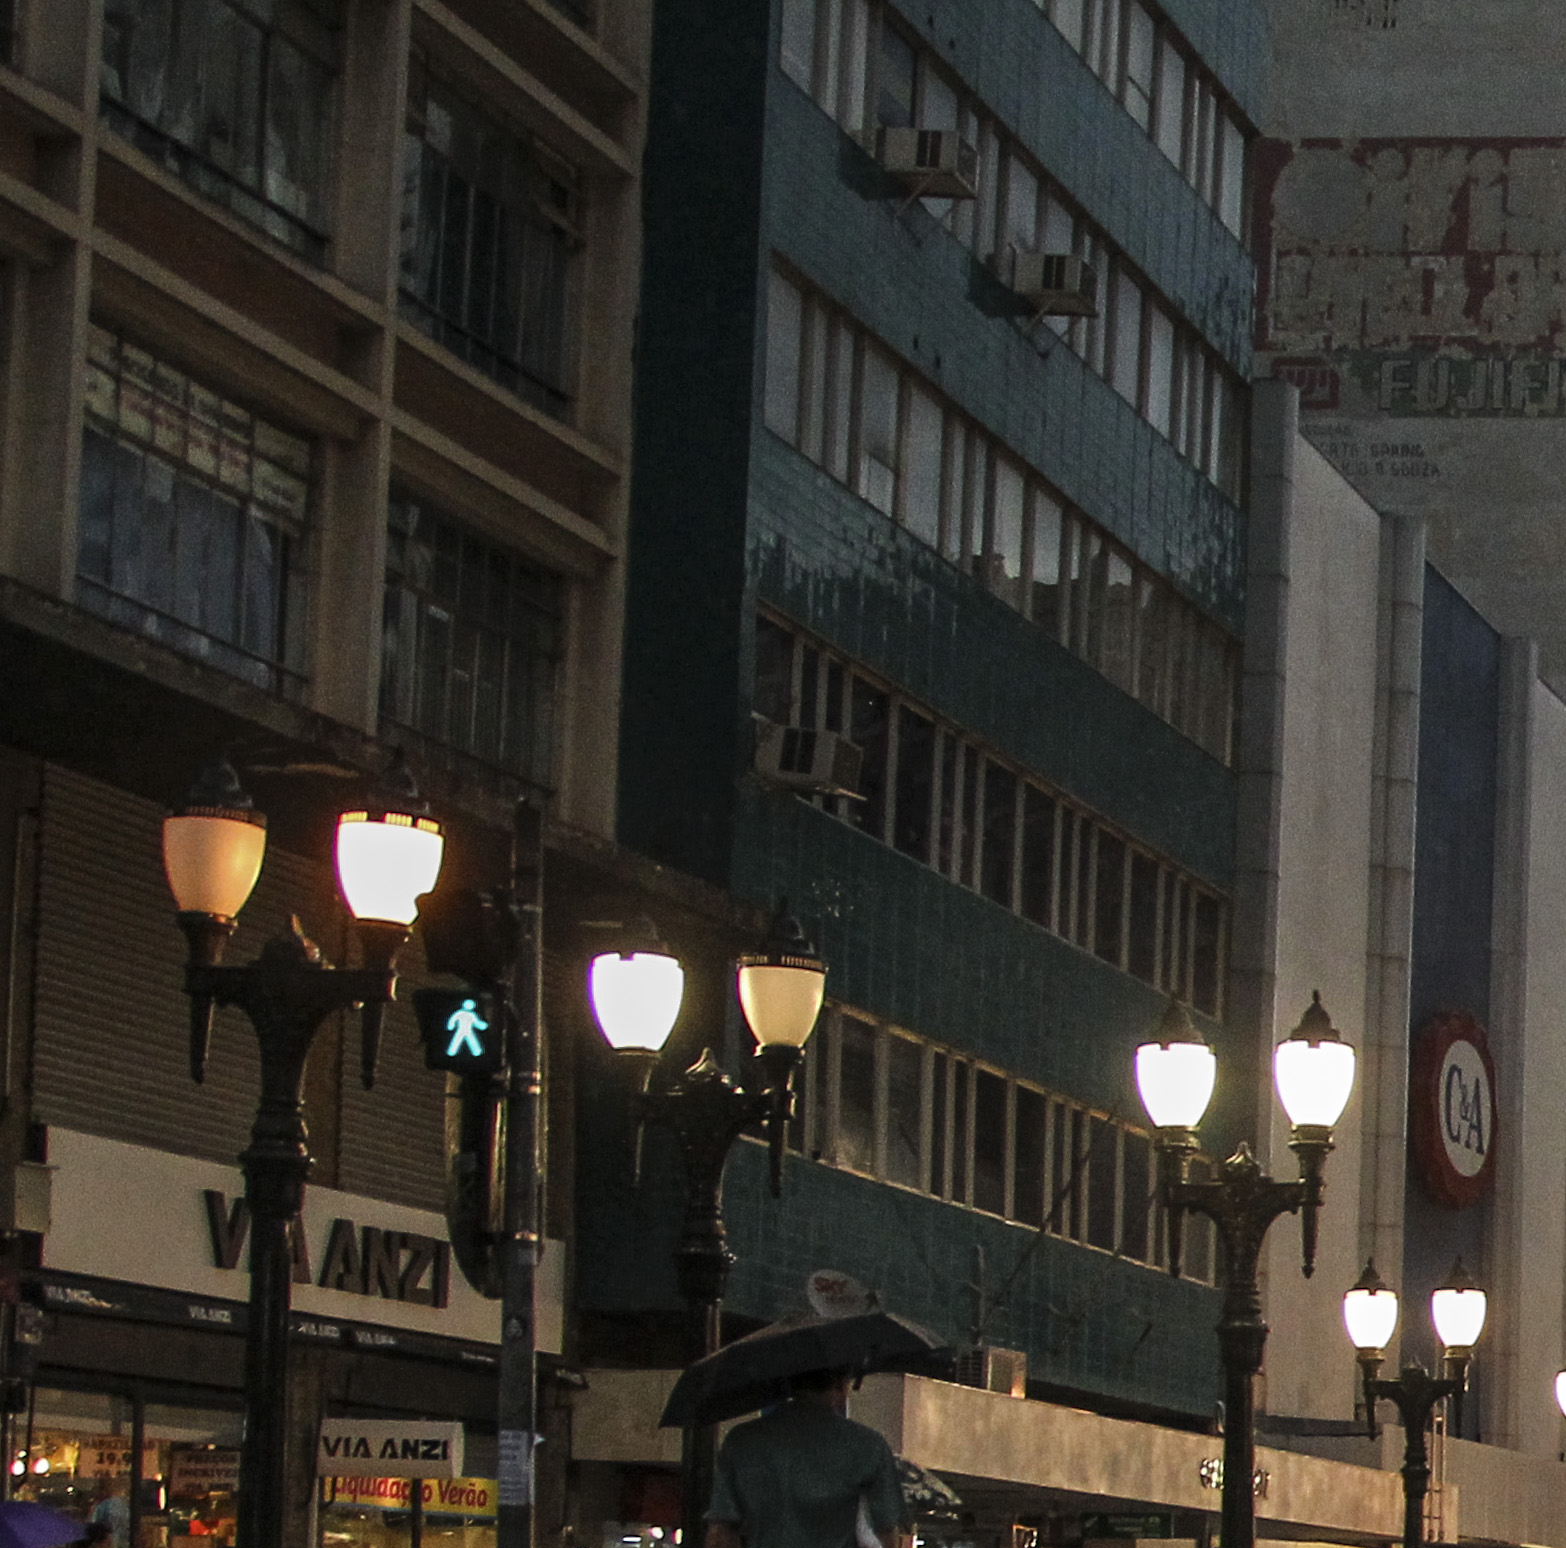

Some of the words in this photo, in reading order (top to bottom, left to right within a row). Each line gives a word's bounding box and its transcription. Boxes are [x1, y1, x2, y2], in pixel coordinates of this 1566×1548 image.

[1445, 1063, 1485, 1155] C&A
[203, 1189, 312, 1285] VA
[317, 1217, 451, 1309] ANZI
[322, 1436, 373, 1459] VIA
[379, 1438, 449, 1461] ANZI
[334, 1475, 433, 1507] Liquidaço
[438, 1478, 489, 1508] Verão
